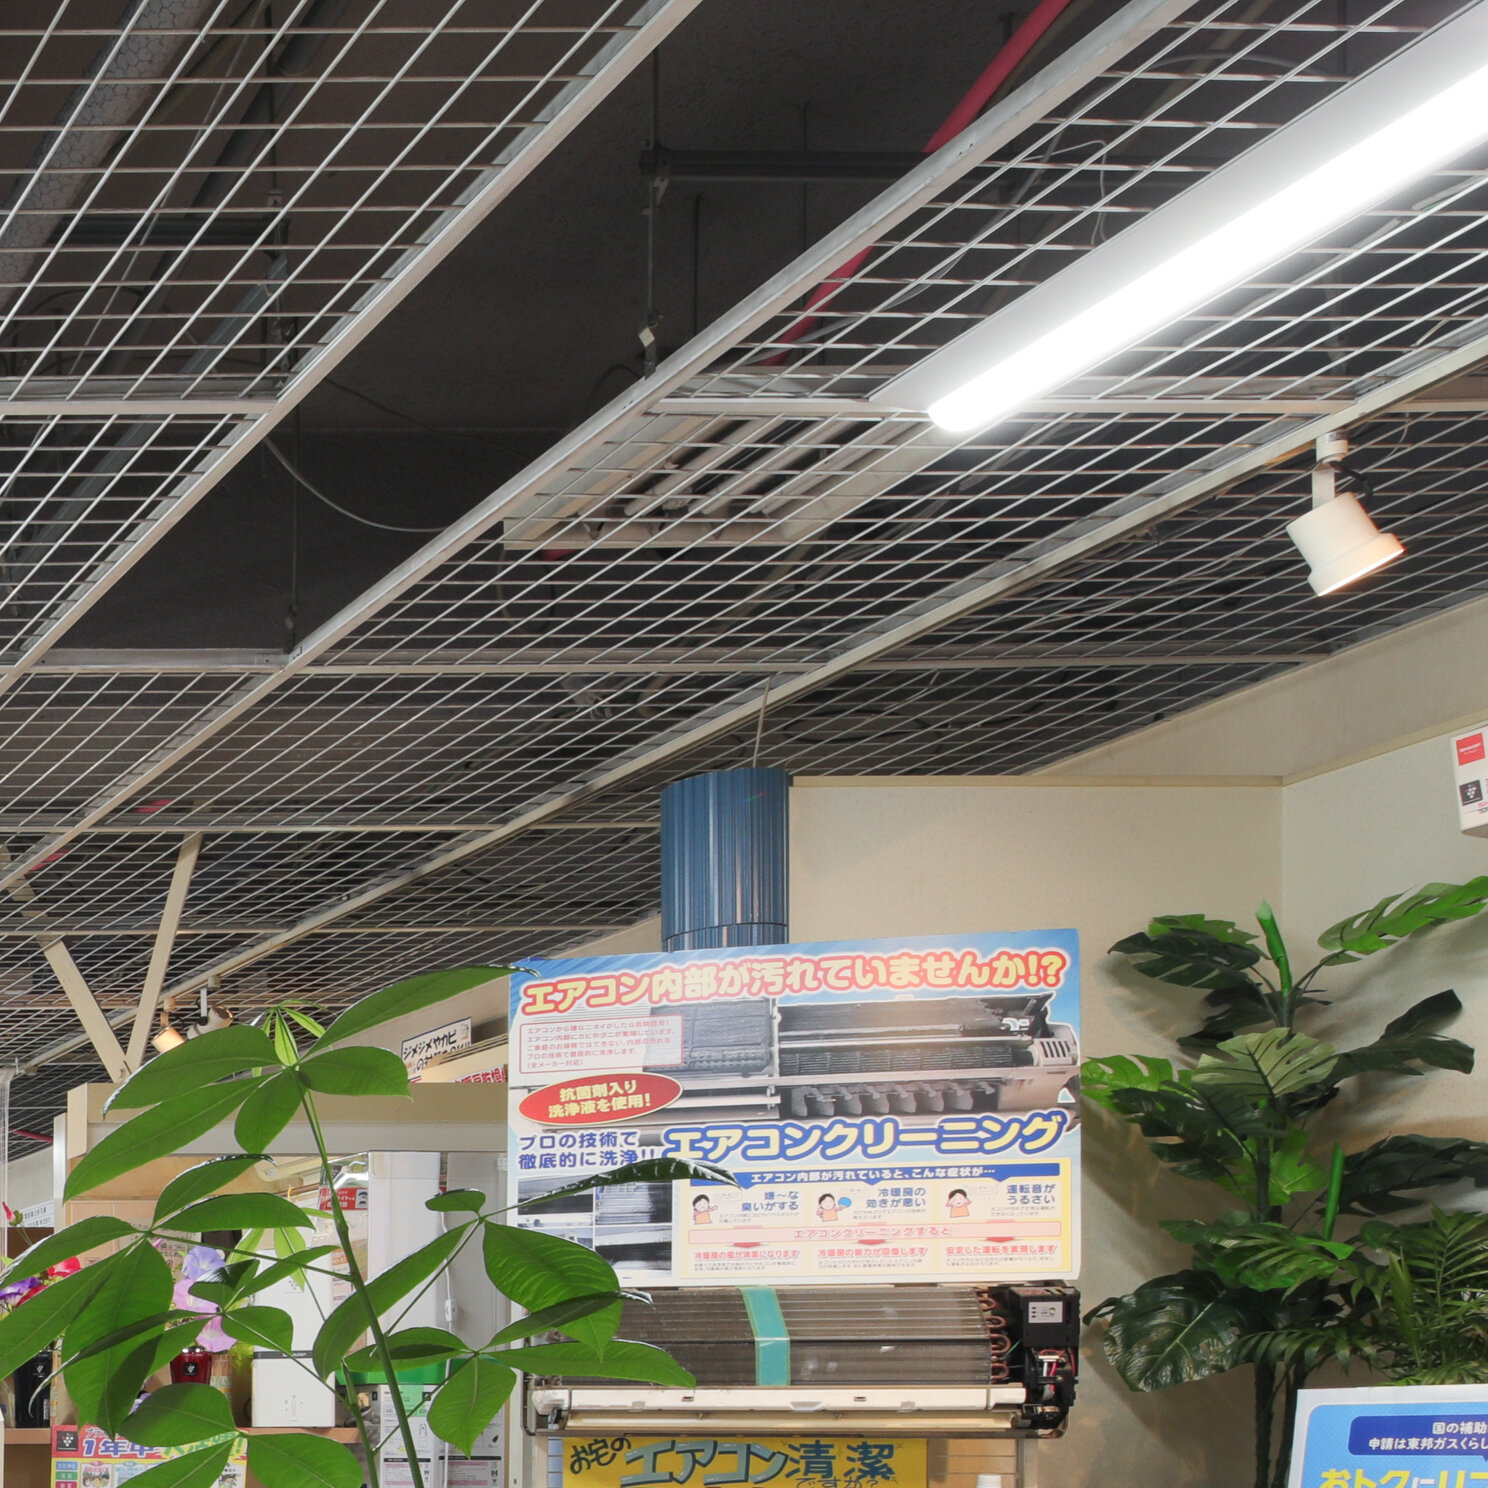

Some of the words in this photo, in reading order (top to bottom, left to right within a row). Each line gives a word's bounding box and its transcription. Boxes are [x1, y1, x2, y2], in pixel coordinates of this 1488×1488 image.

[559, 1080, 638, 1102] 抗菌剤入り
[519, 1131, 639, 1151] プロの技術で
[664, 1113, 1065, 1158] エアコンクリーニング
[878, 1187, 926, 1197] 冷暖房の
[1006, 1183, 1056, 1194] 運転音が
[741, 1200, 800, 1212] 臭いがする
[866, 1197, 926, 1209] 効きが悪い
[1007, 1195, 1056, 1205] うるさい
[794, 1225, 952, 1240] エアコンクリーニングすると
